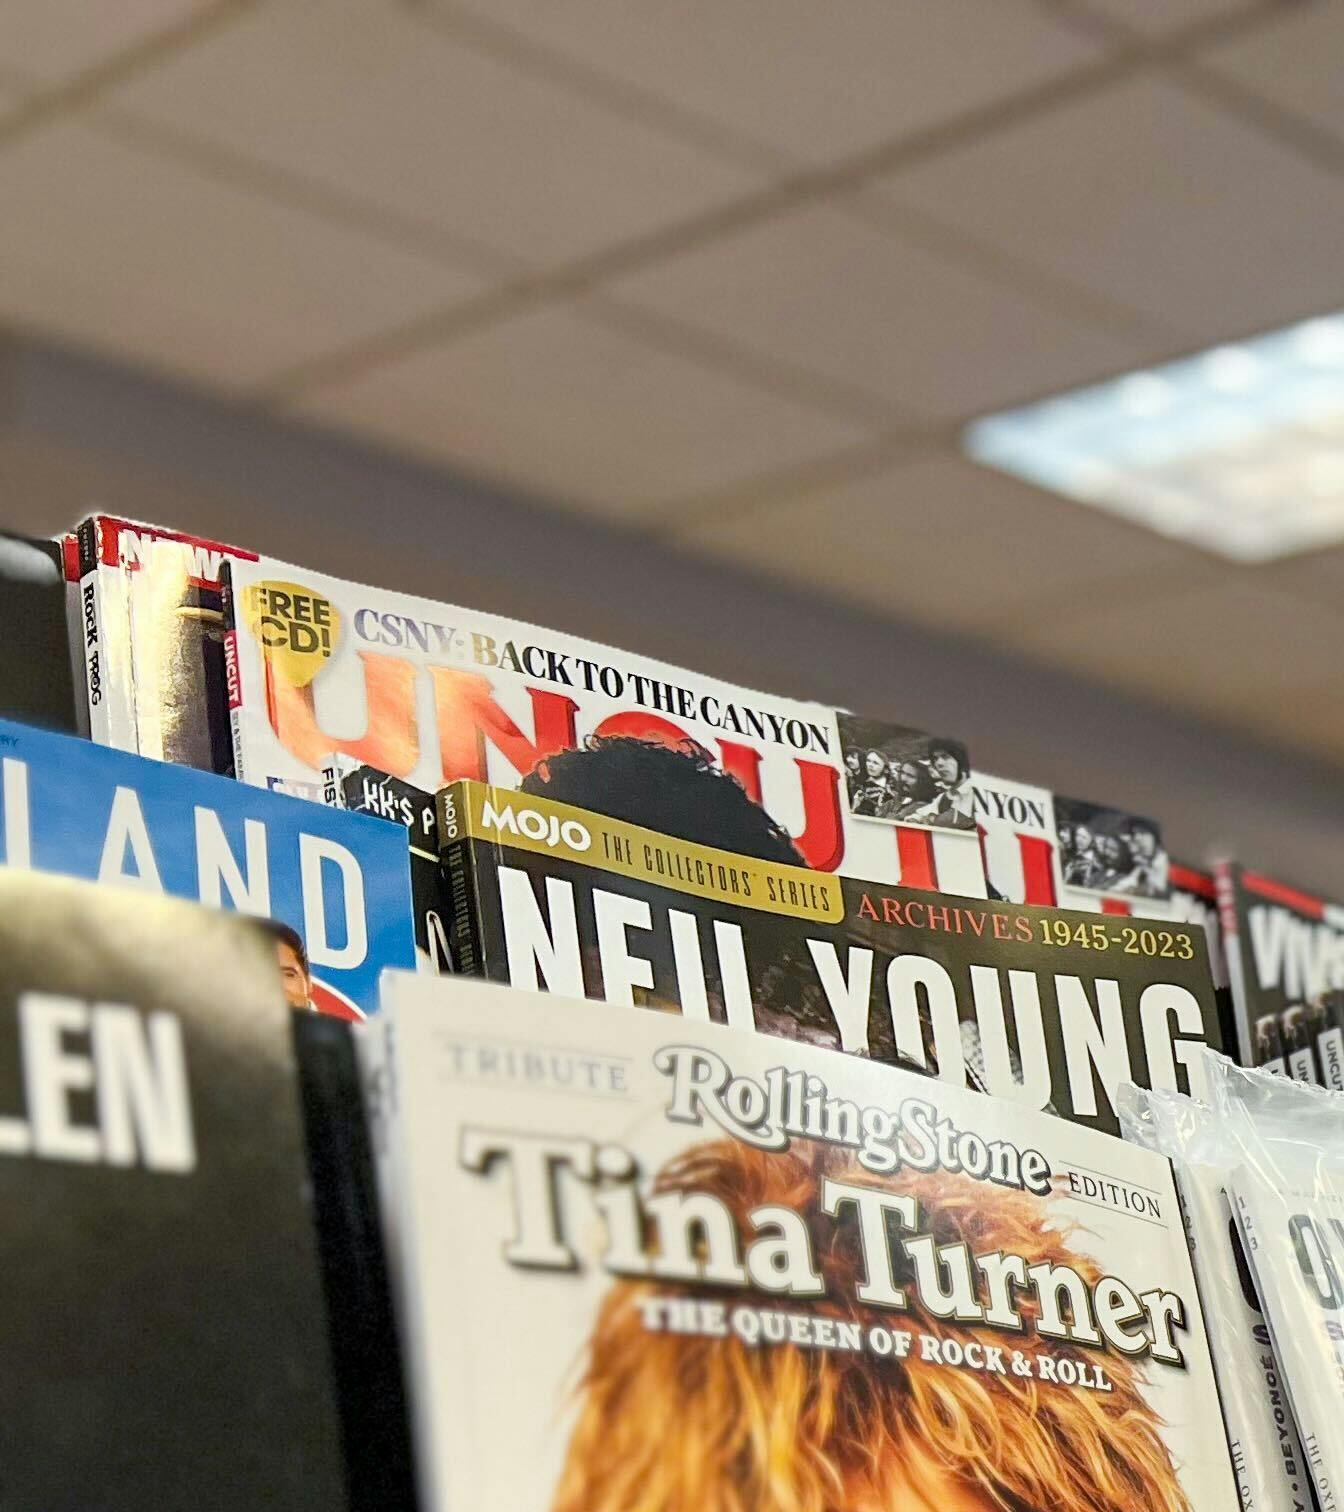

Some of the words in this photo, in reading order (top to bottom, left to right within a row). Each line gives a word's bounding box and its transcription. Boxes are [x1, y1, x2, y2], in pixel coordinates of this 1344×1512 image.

[252, 588, 329, 627] FREE
[260, 614, 331, 658] CD!
[223, 634, 242, 703] UNCUT
[473, 633, 572, 686] BACK
[576, 659, 624, 698] TO
[627, 672, 697, 720] THE
[699, 695, 831, 756] CANYON
[444, 793, 458, 839] MOJO
[481, 800, 593, 858] MOJO
[601, 831, 633, 867] THE
[766, 875, 832, 913] SERIES
[855, 893, 1034, 943] ARCHIVES
[1038, 918, 1195, 961] 1945-2023
[806, 937, 1208, 1123] YOUNG
[444, 1042, 629, 1093] TRIBUTE
[1066, 1169, 1162, 1220] EDITION
[456, 1124, 824, 1298] Tina
[819, 1178, 1189, 1370] Turner
[639, 1298, 727, 1337] THE
[730, 1304, 863, 1352] QUEEN
[868, 1326, 915, 1359] OF
[919, 1333, 1006, 1376] ROCK
[1010, 1352, 1034, 1379] &
[1035, 1354, 1114, 1393] ROLL
[1231, 1440, 1248, 1475] THE
[1306, 1432, 1325, 1469] THE
